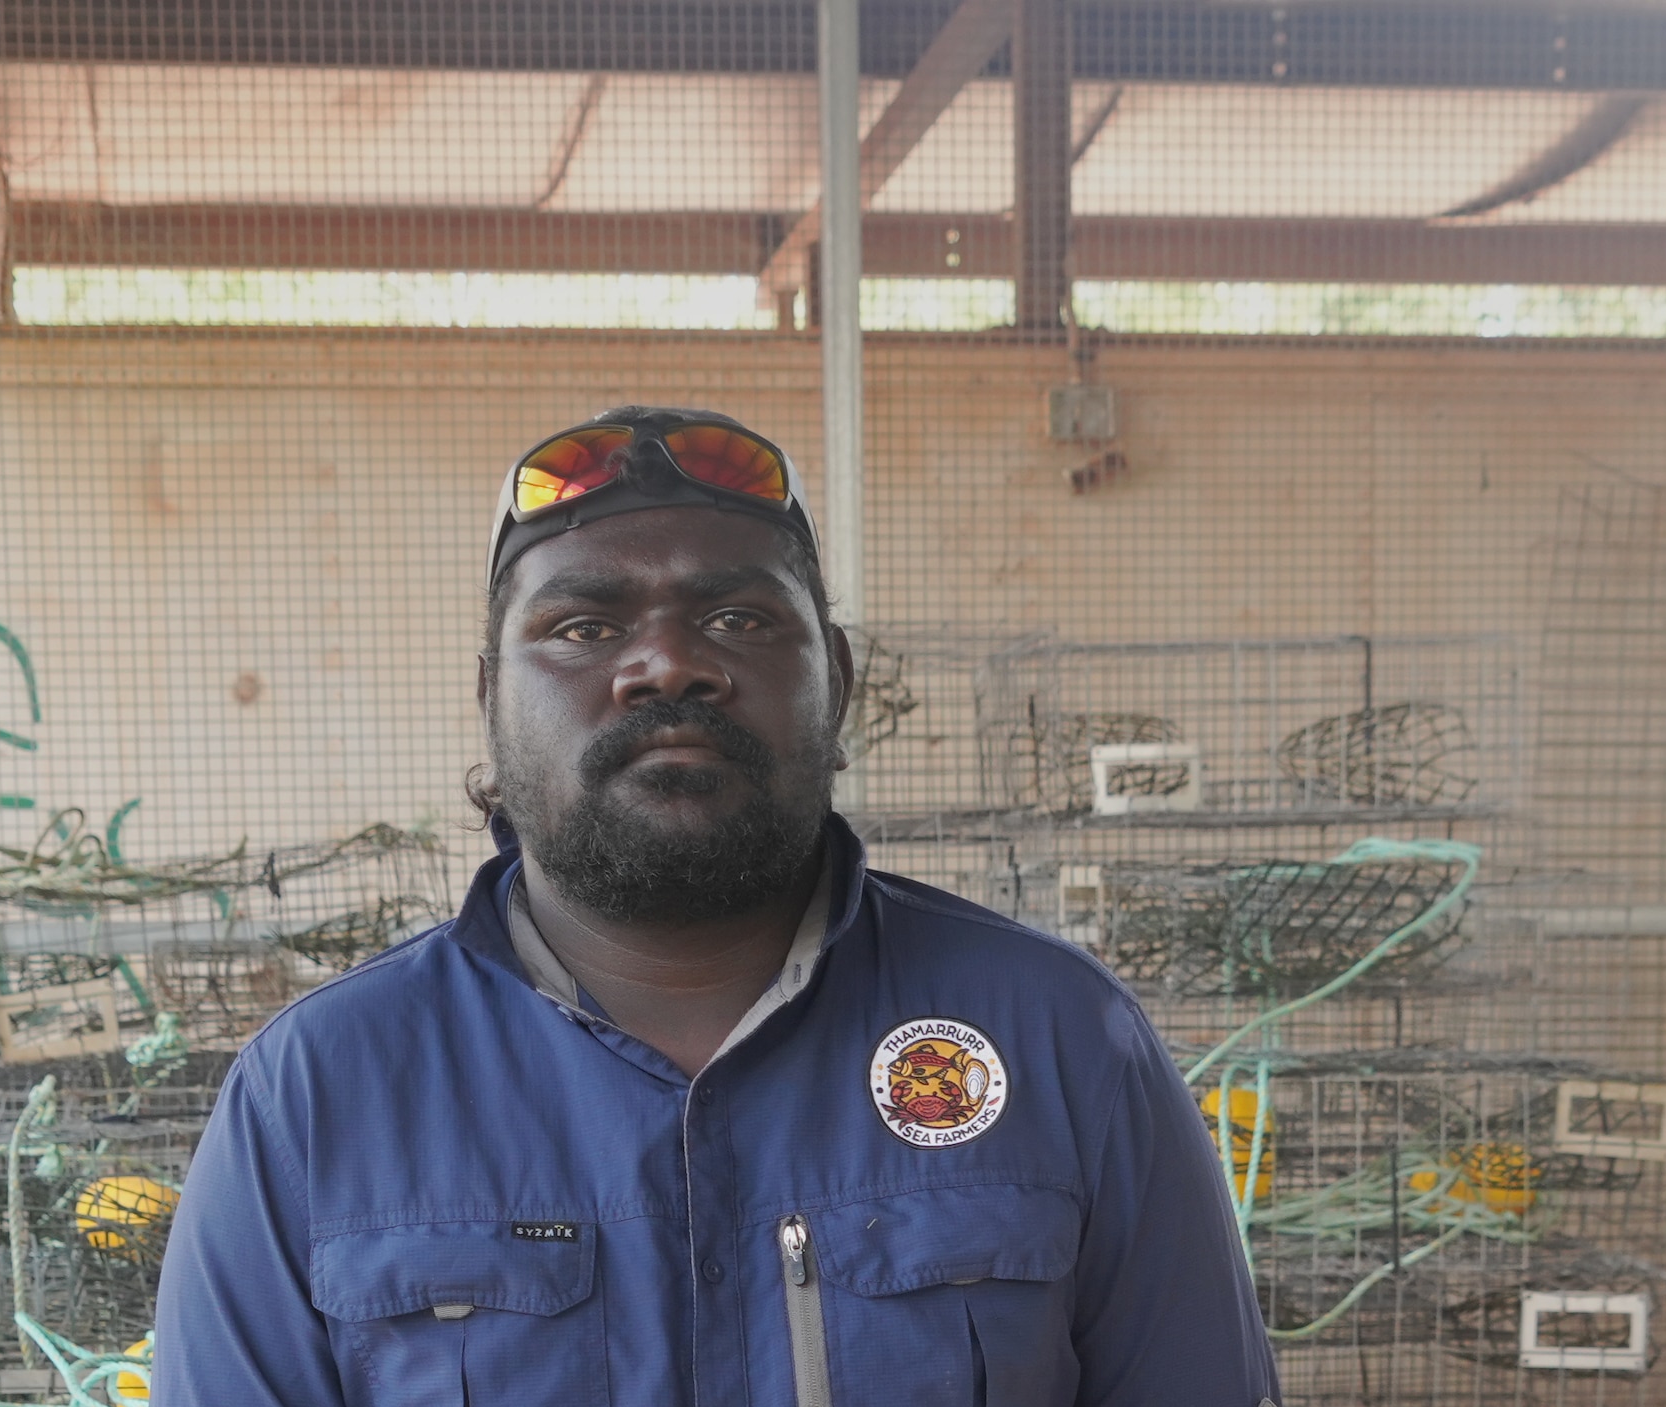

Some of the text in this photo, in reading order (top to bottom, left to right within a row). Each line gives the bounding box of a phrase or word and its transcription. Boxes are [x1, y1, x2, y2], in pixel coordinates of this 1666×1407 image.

[884, 1023, 985, 1054] THAMARRURR
[902, 1108, 997, 1144] SEA FARMERS
[516, 1225, 573, 1238] SYZMIK
